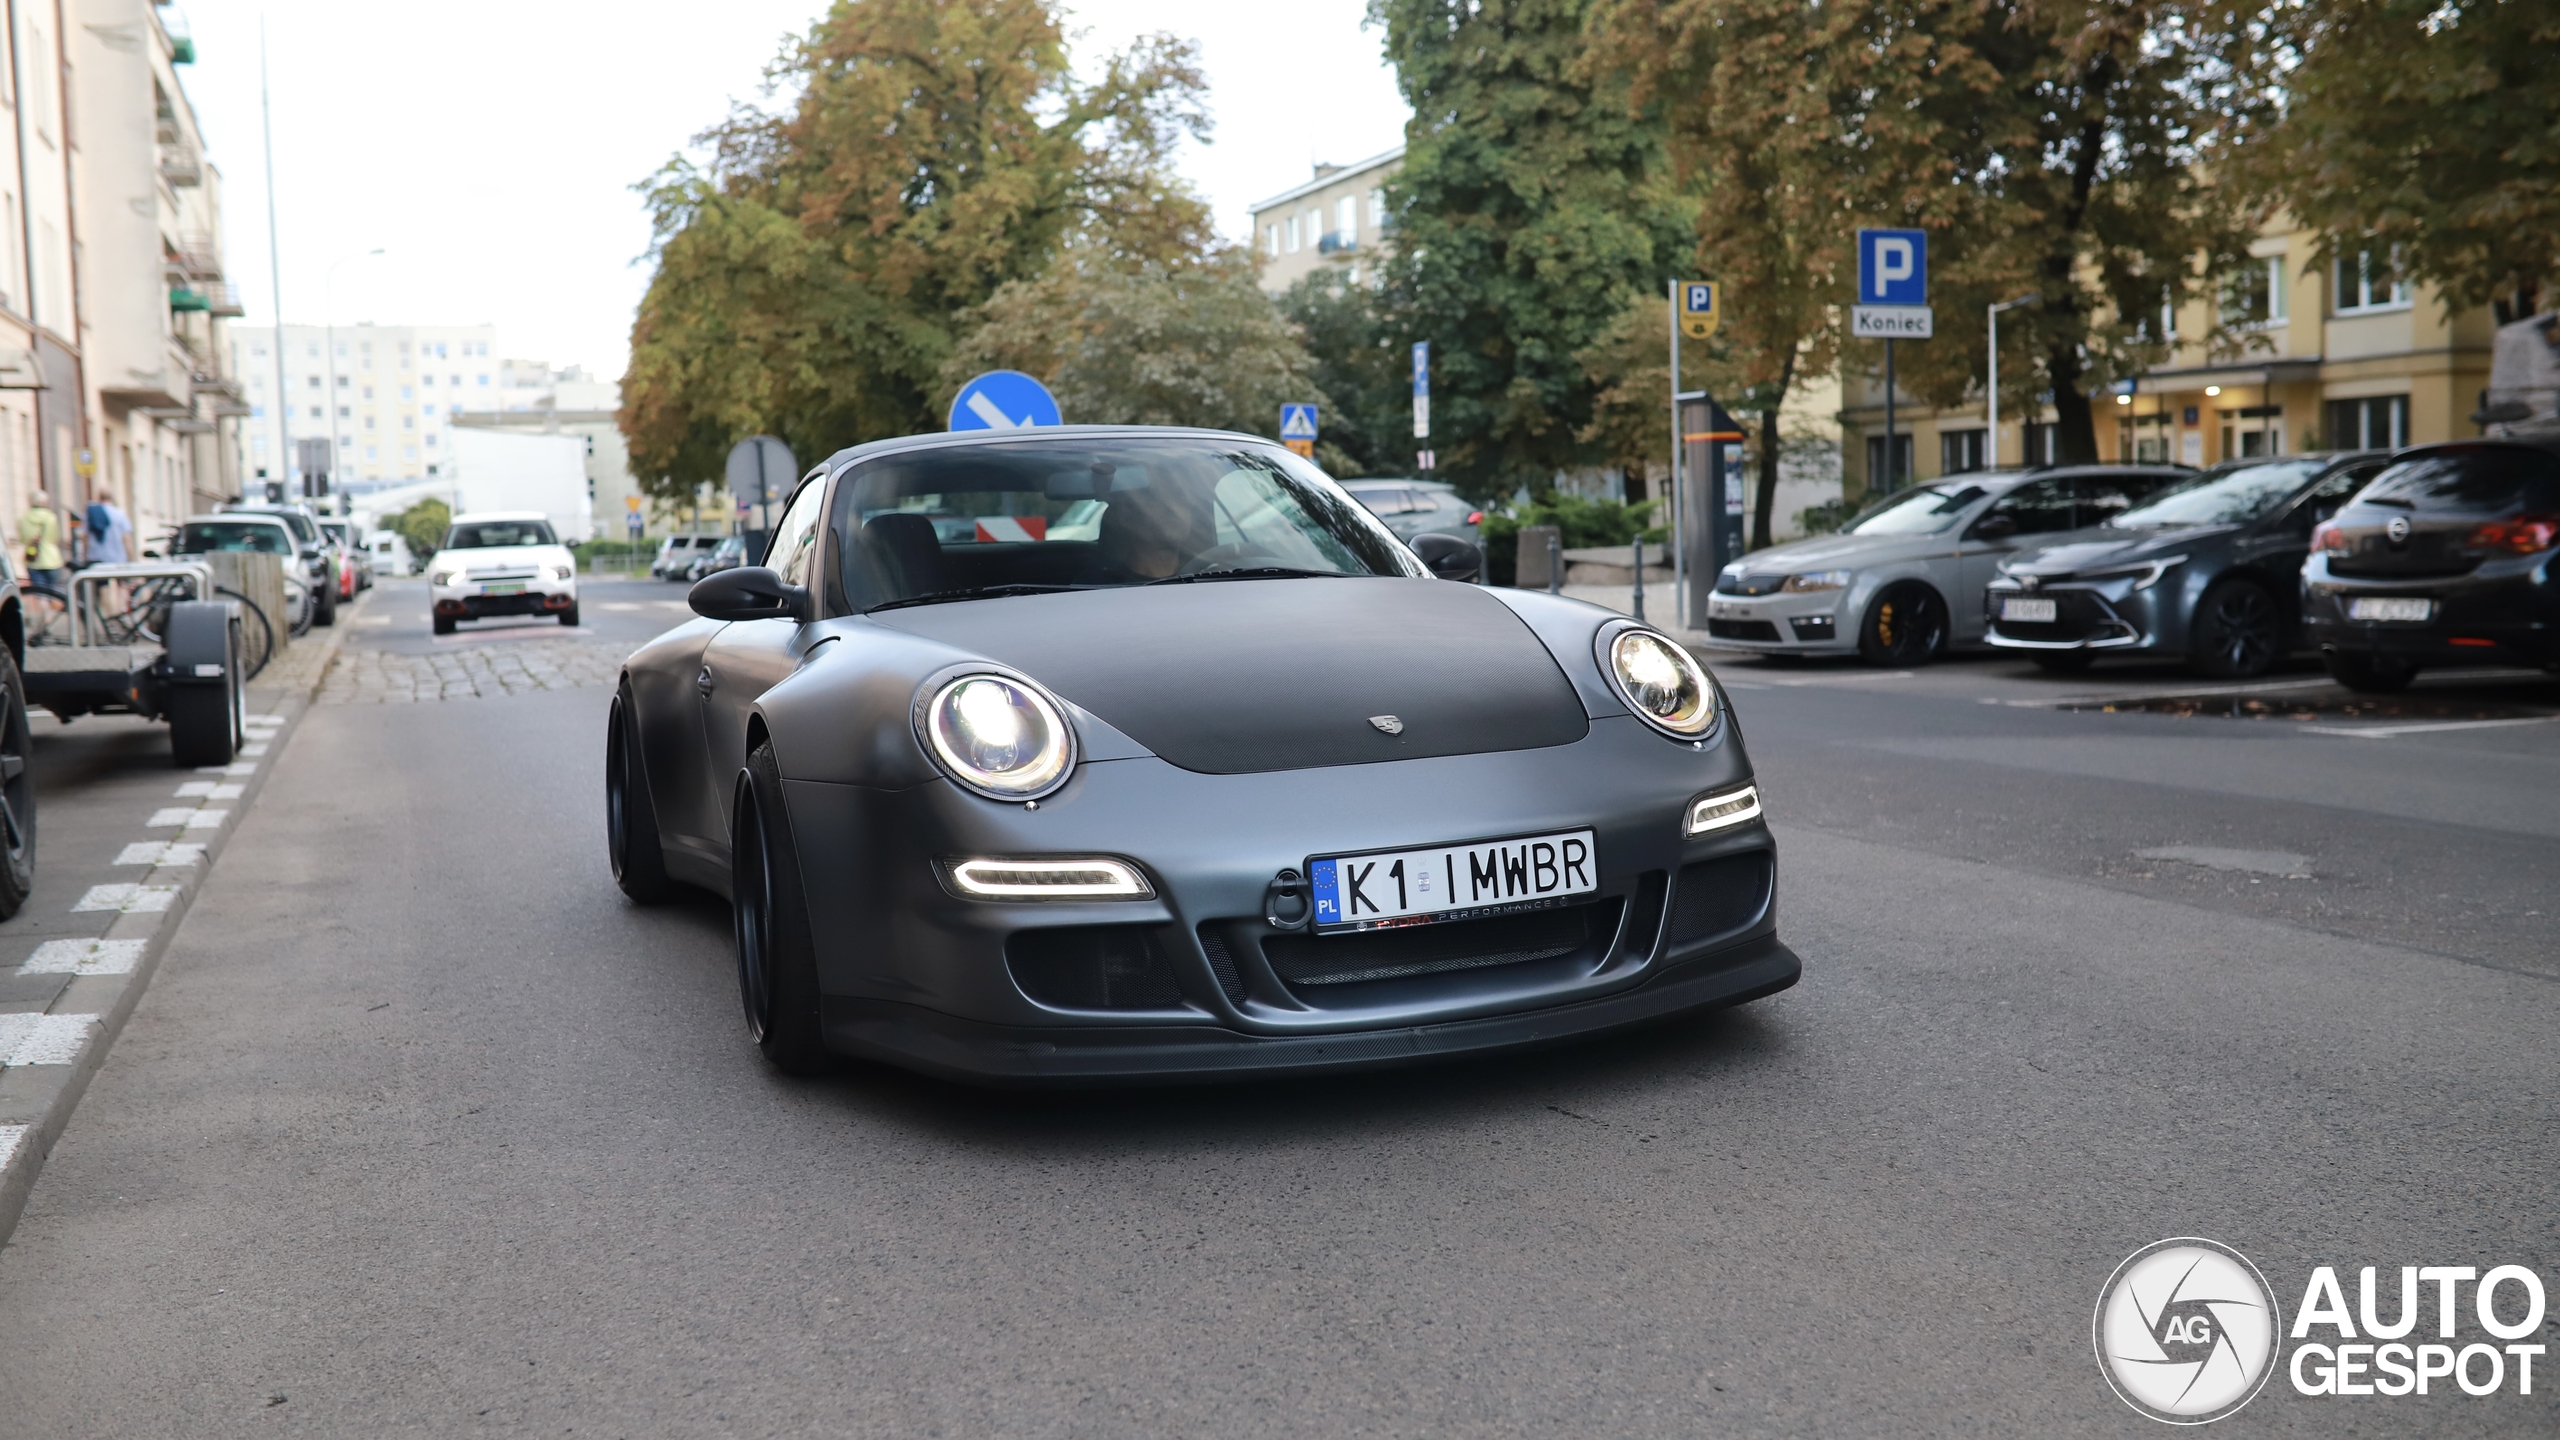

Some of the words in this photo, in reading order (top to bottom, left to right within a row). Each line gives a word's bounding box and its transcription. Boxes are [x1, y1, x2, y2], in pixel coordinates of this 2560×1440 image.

[1874, 237, 1914, 297] P
[1691, 286, 1708, 310] P
[1859, 311, 1926, 332] Koniec
[1347, 858, 1408, 915] K1
[1317, 899, 1338, 915] PL
[1438, 899, 1552, 921] PERFORMANCE
